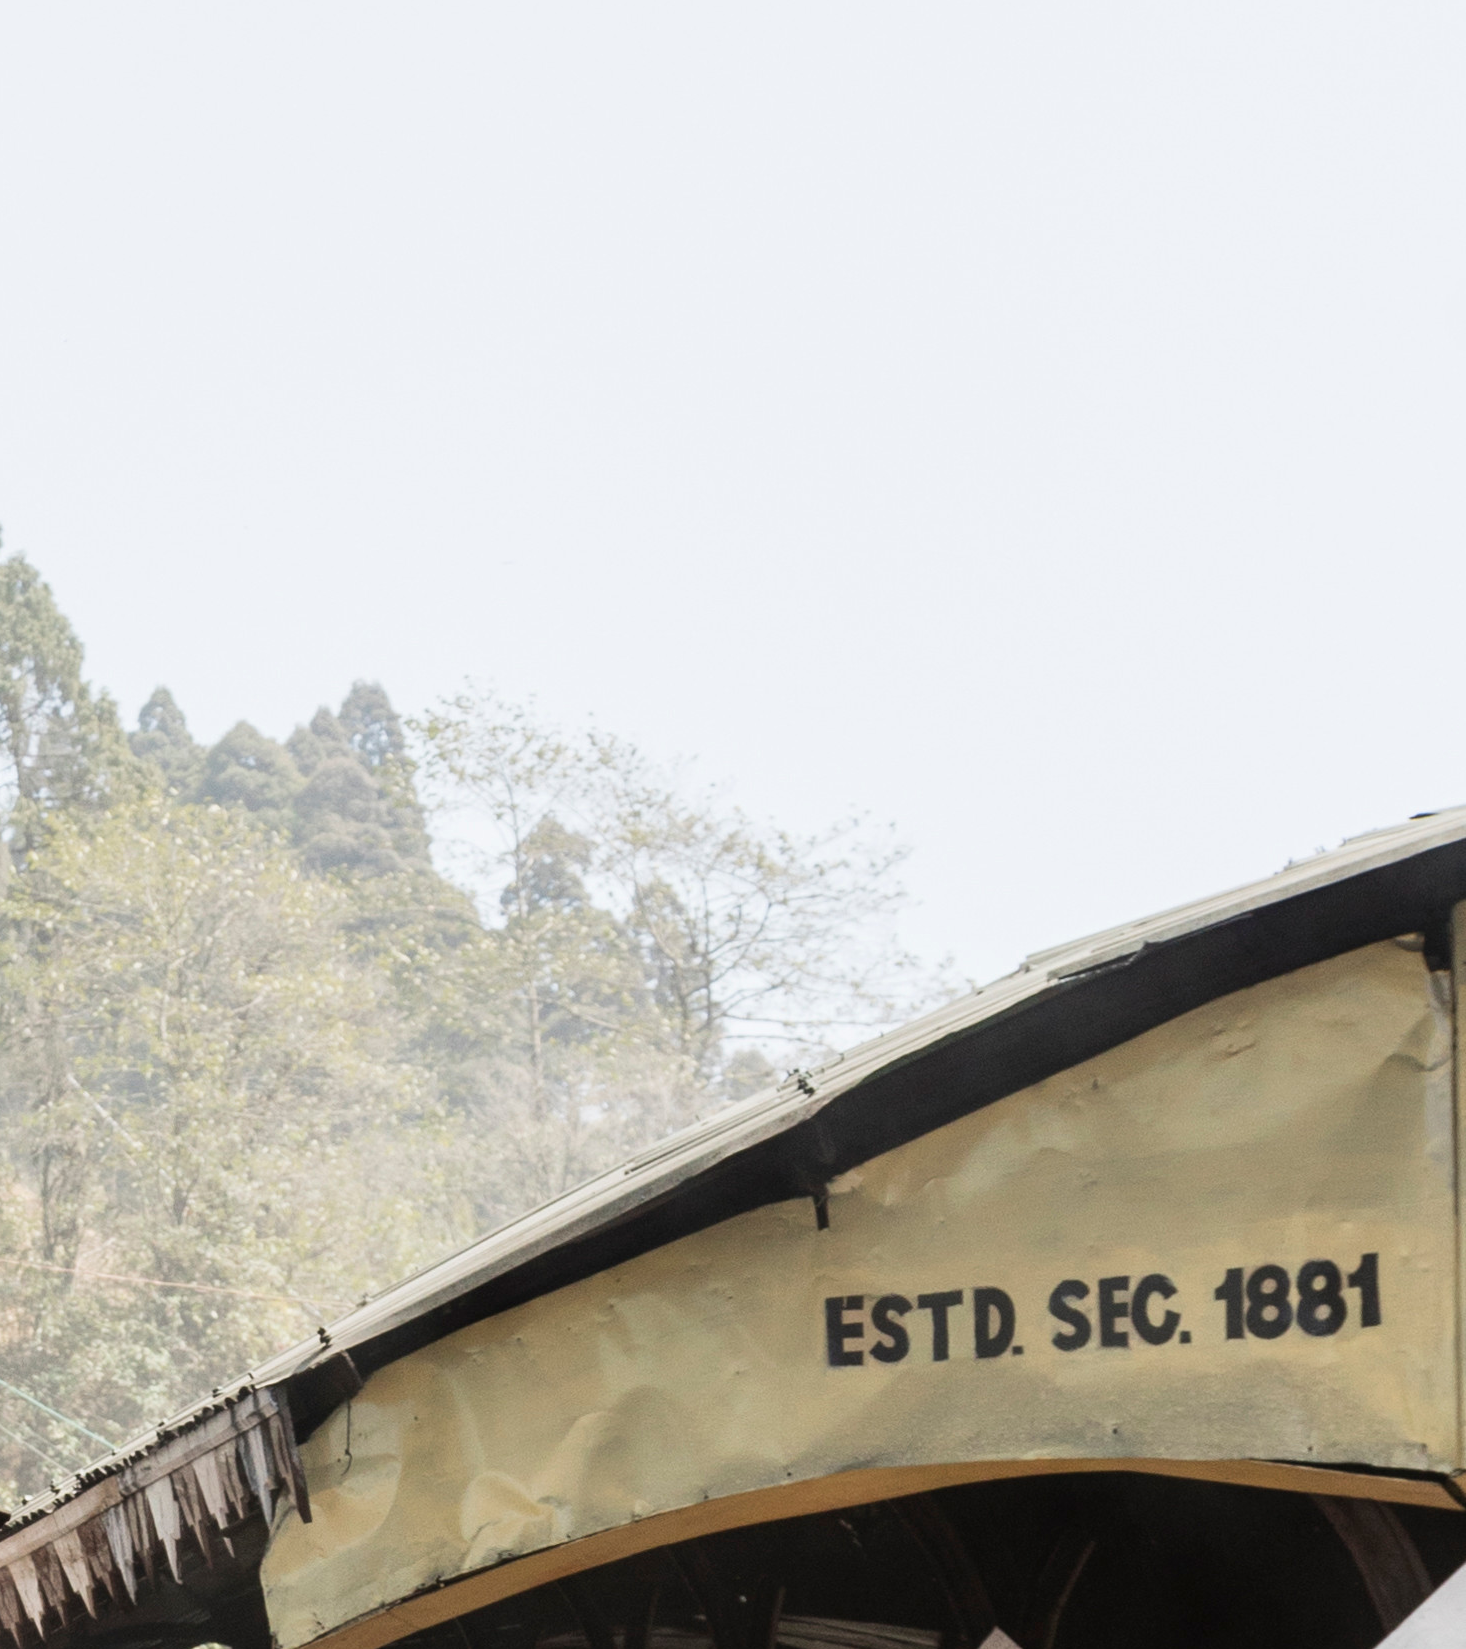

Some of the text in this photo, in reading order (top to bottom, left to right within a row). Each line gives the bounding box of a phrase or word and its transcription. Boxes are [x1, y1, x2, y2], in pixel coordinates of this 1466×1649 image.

[825, 1252, 1381, 1367] ESTD. SEC. 1881
